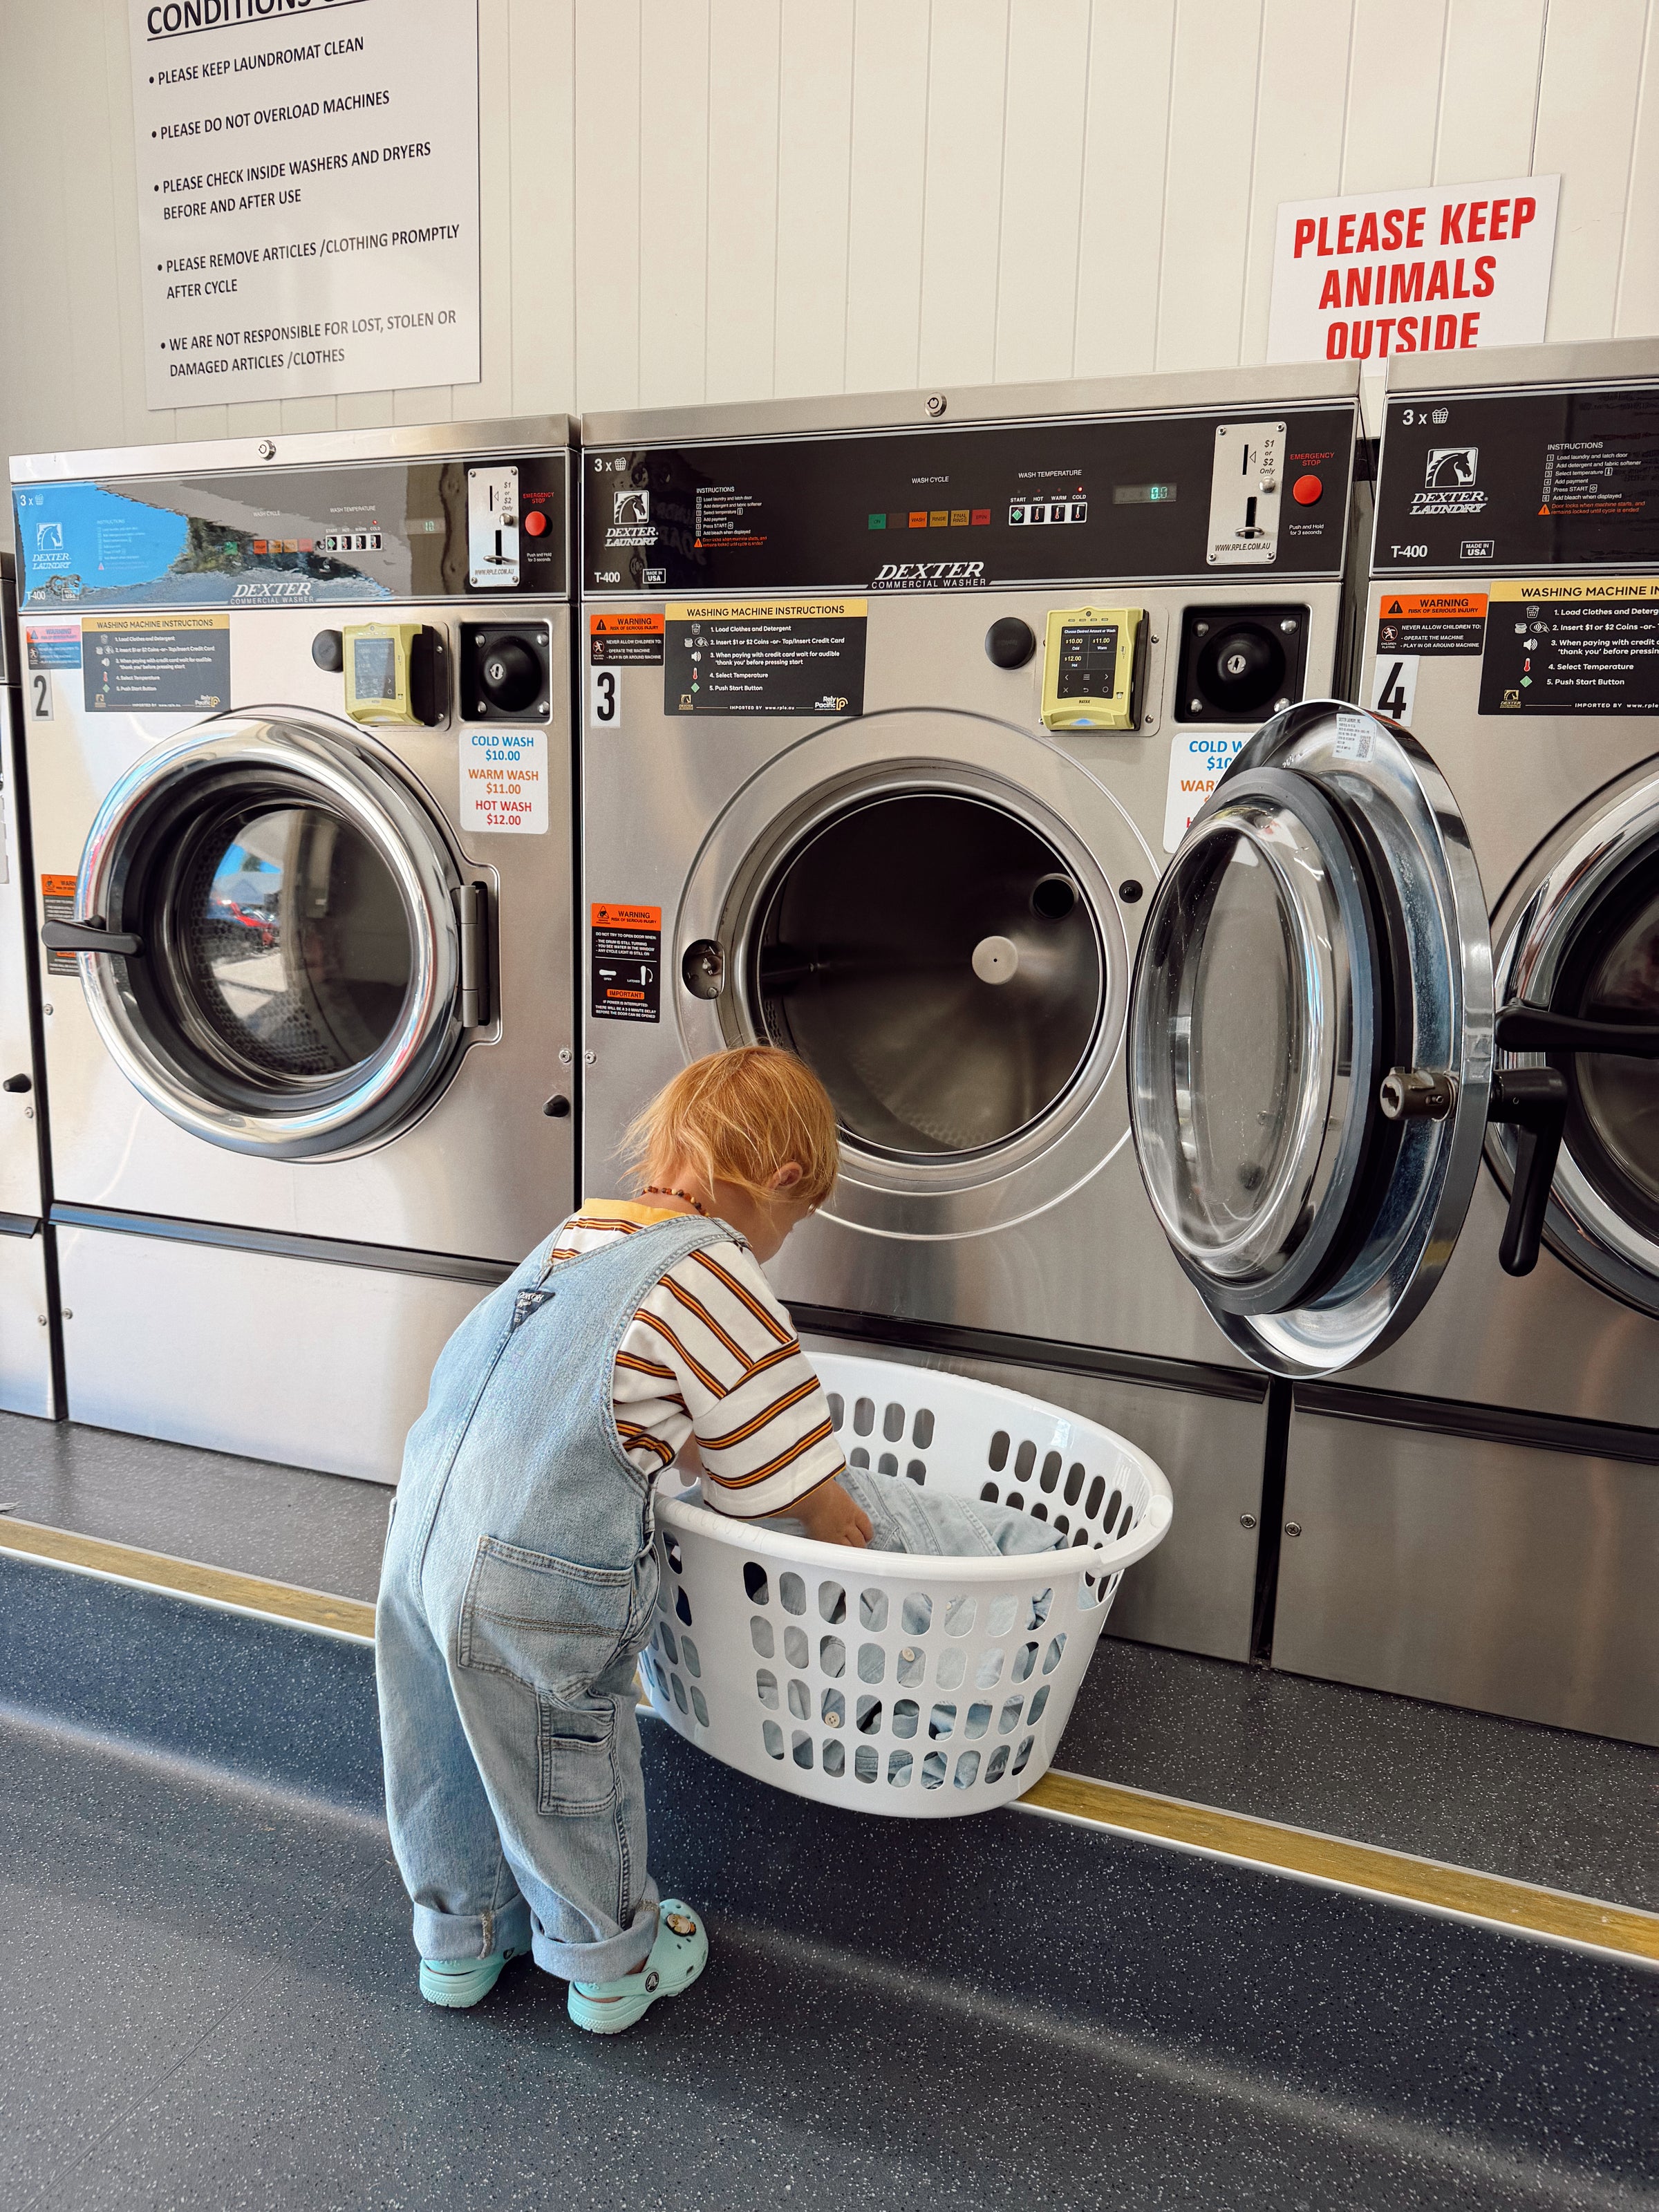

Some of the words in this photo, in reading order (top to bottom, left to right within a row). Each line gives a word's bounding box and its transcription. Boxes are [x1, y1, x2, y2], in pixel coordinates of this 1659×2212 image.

[147, 0, 310, 35] CONDITIO
[158, 66, 198, 84] PLEASE
[203, 60, 230, 77] KEEP
[234, 44, 321, 72] LAUNDROMAT
[324, 37, 364, 56] CLEAN
[161, 122, 201, 140] PLEASE
[205, 119, 222, 133] DO
[226, 113, 250, 130] NOT
[254, 103, 319, 125] OVERLOAD
[323, 91, 389, 115] MACHINES
[163, 176, 203, 193] PLEASE
[207, 170, 243, 187] CHECK
[247, 164, 285, 181] INSIDE
[289, 155, 348, 176] WASHERS
[351, 150, 379, 167] AND
[383, 142, 431, 161] DRYERS
[164, 203, 207, 220] BEFORE
[210, 198, 235, 214] AND
[238, 194, 275, 210] AFTER
[279, 189, 301, 203] USE
[1294, 207, 1426, 259] PLEASE
[1441, 196, 1536, 245] KEEP
[167, 256, 206, 272] PLEASE
[209, 250, 259, 268] REMOVE
[263, 243, 316, 261] ARTICLES
[320, 234, 388, 257] /CLOTHING
[392, 224, 459, 246] PROMPTLY
[167, 283, 201, 299] AFTER
[205, 279, 237, 294] CYCLE
[1319, 256, 1497, 310] ANIMALS
[169, 338, 187, 350] WE
[191, 335, 212, 348] ARE
[216, 332, 240, 346] NOT
[244, 324, 321, 344] RESPONSIBLE
[325, 322, 348, 335] FOR
[353, 318, 384, 333] LOST,
[387, 312, 433, 330] STOLEN
[438, 310, 456, 324] OR
[1326, 312, 1480, 359] OUTSIDE
[170, 359, 228, 377] DAMAGED
[232, 354, 283, 371] ARTICLES
[287, 348, 345, 368] /CLOTHES
[1403, 409, 1414, 426] 3
[1548, 442, 1603, 450] INSTRUCTIONS
[594, 458, 602, 471] 3
[20, 495, 26, 506] 3
[1411, 491, 1485, 504] DEXTER
[1409, 504, 1487, 514] LAUNDRY
[606, 527, 656, 537] DEXTER
[605, 537, 658, 547] LAUNDRY
[1215, 543, 1271, 552] WWW.RPLE.COM.AU
[1391, 545, 1427, 558] T-400
[1467, 547, 1486, 556] USA
[32, 554, 69, 562] DEXTER
[32, 561, 71, 570] LAUNDRY
[874, 561, 984, 580] DEXTER
[594, 572, 620, 583] T-400
[872, 579, 939, 589] COMMERCIAL
[943, 578, 986, 587] WASHER
[26, 590, 46, 600] T-400
[232, 583, 311, 597] DEXTER
[1521, 588, 1582, 597] WASHING
[1586, 586, 1647, 597] MACHINE
[1420, 599, 1468, 607] WARNING
[687, 608, 729, 617] WASHING
[731, 607, 774, 616] MACHINE
[775, 605, 845, 615] INSTRUCTIONS
[34, 675, 48, 716] 2
[597, 672, 615, 721] 3
[1378, 662, 1406, 719] 4
[471, 735, 499, 747] COLD
[502, 737, 534, 747] WASH
[1189, 741, 1227, 752] COLD
[486, 748, 520, 761] $10.00
[469, 769, 503, 780] WARM
[506, 770, 538, 781] WASH
[487, 782, 521, 794] $11.00
[1181, 780, 1215, 791] WAR
[476, 800, 497, 810] HOT
[500, 801, 532, 812] WASH
[487, 813, 521, 825] $12.00
